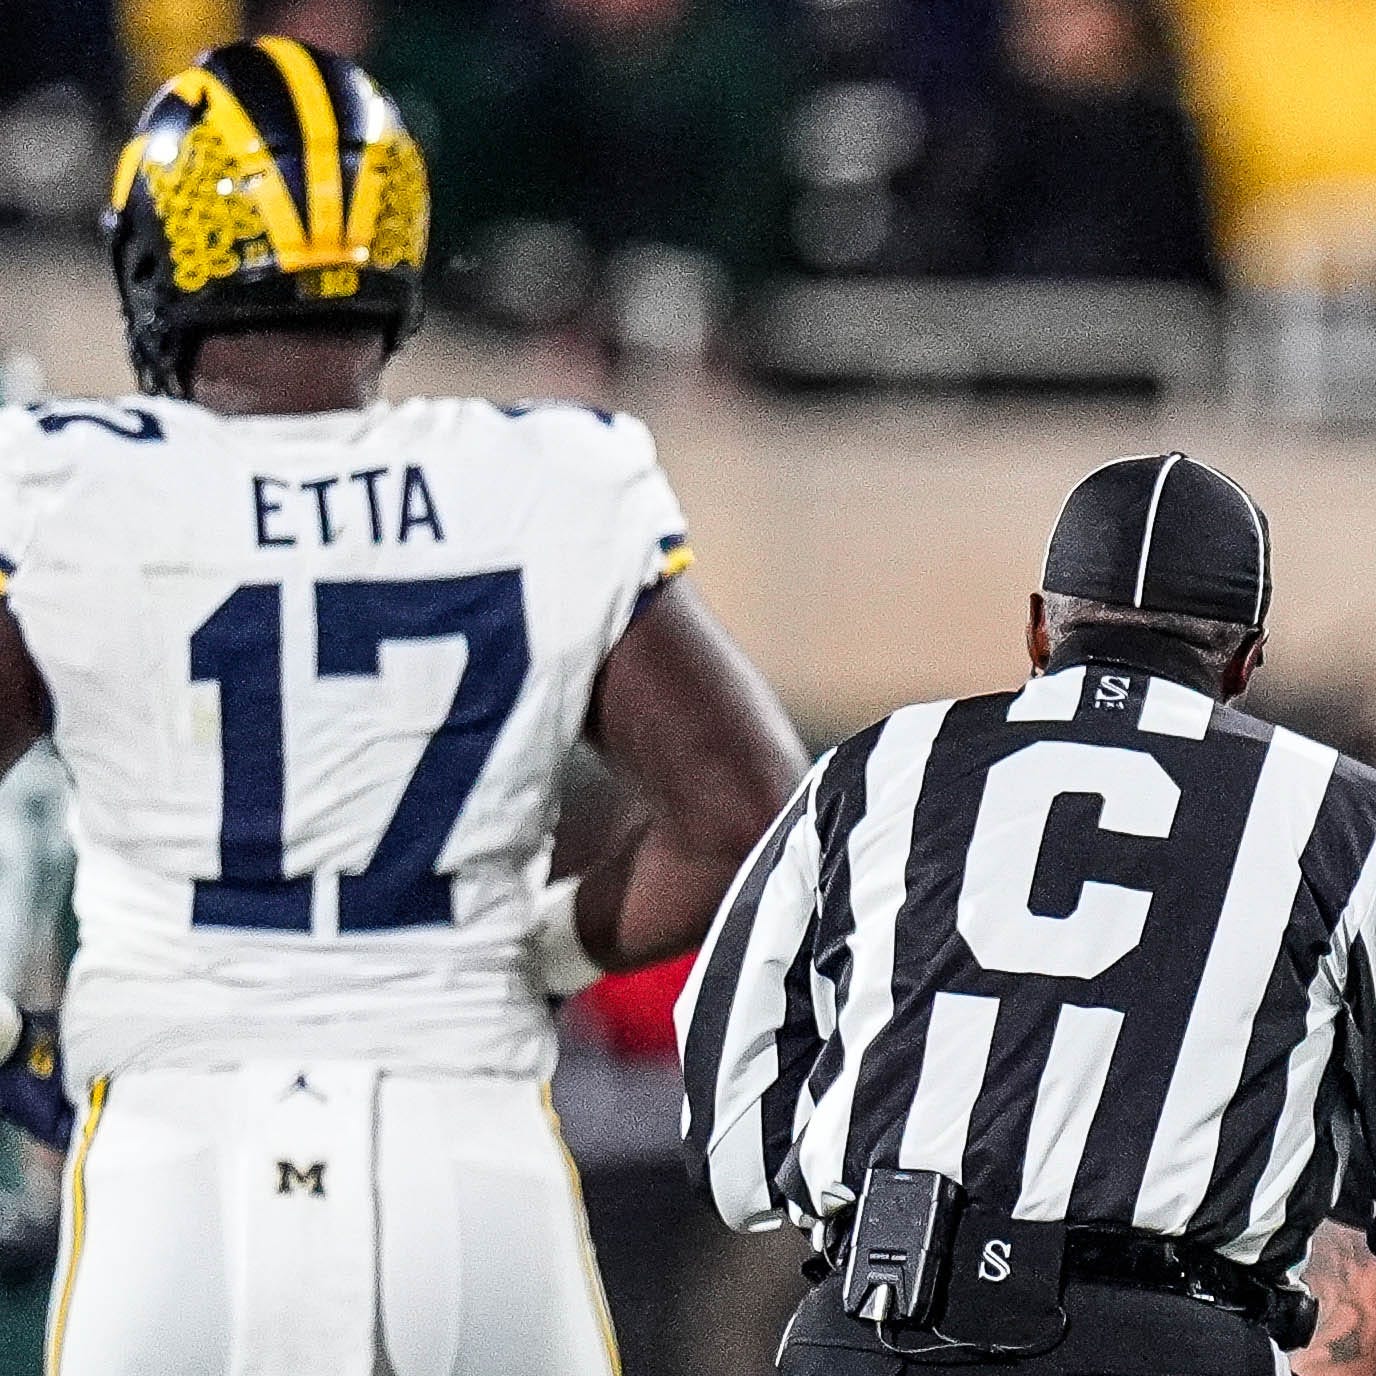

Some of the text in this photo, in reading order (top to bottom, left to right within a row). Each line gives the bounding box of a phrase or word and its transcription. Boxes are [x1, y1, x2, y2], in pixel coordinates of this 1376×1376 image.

[253, 465, 445, 547] ETTA
[189, 567, 532, 937] 17
[956, 740, 1181, 980] C
[275, 1161, 327, 1199] M
[978, 1240, 1012, 1282] S
